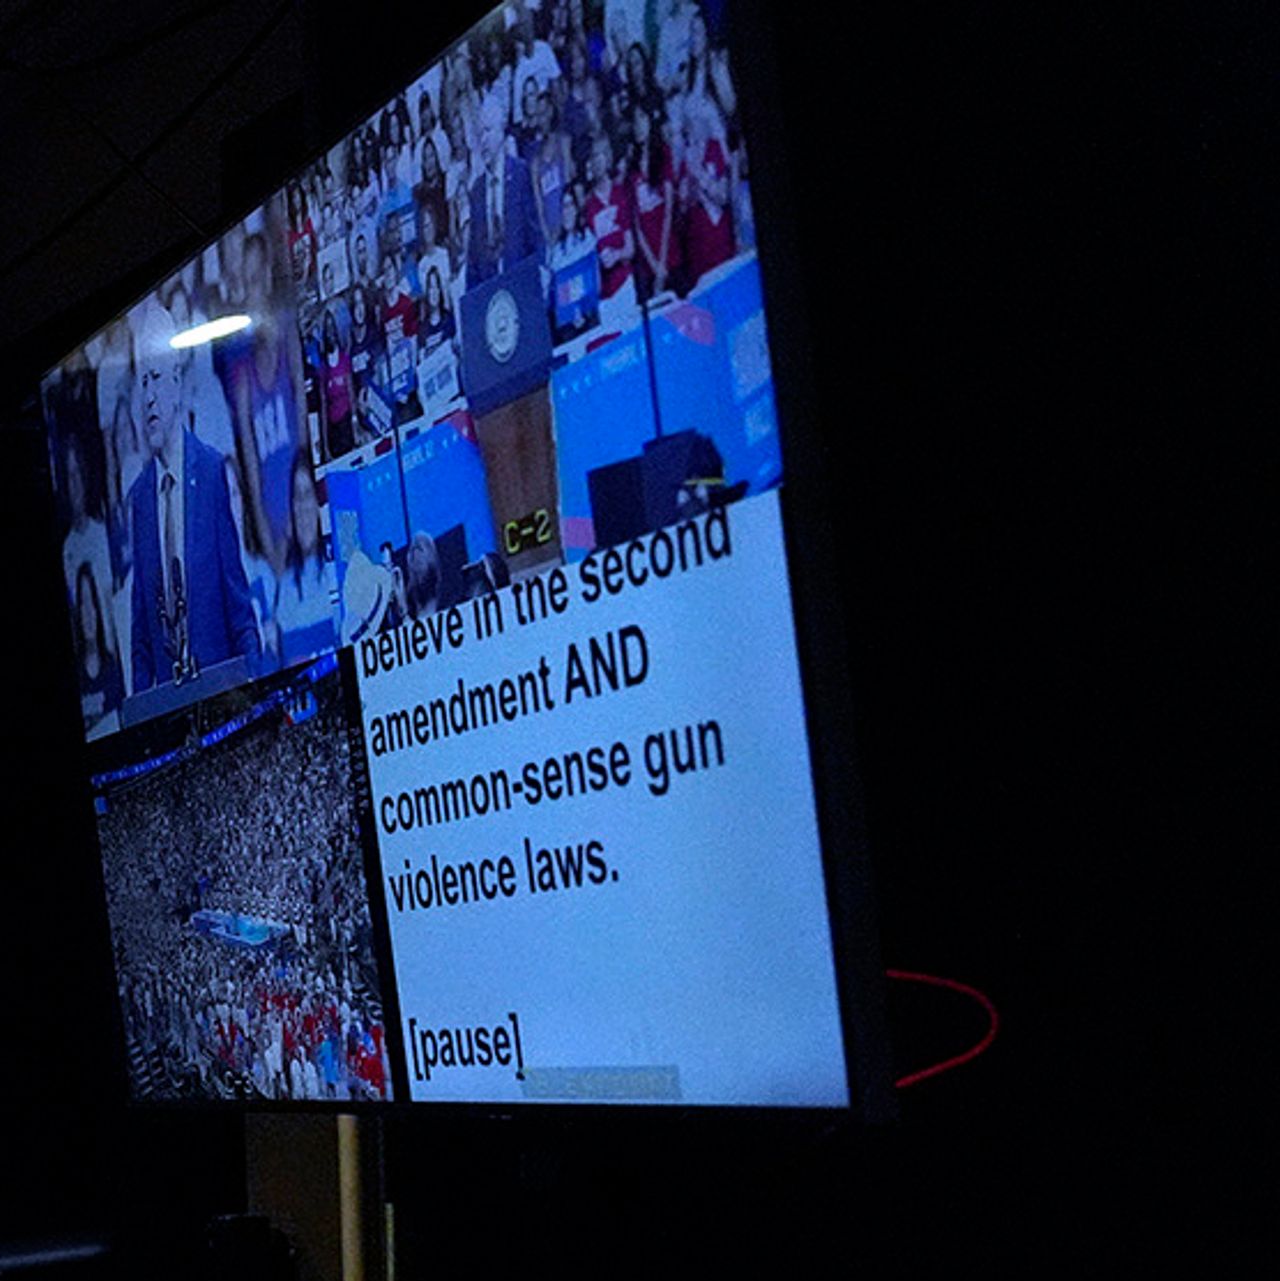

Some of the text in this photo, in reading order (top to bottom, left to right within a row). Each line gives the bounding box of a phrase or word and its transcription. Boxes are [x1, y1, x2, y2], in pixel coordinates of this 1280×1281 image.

[473, 594, 503, 639] in
[580, 505, 732, 602] second
[504, 509, 551, 554] C-2
[371, 656, 554, 756] amendment
[566, 624, 650, 704] AND
[381, 718, 725, 834] common-sense gun
[389, 838, 620, 912] violence laws.
[409, 1013, 525, 1080] [pause]
